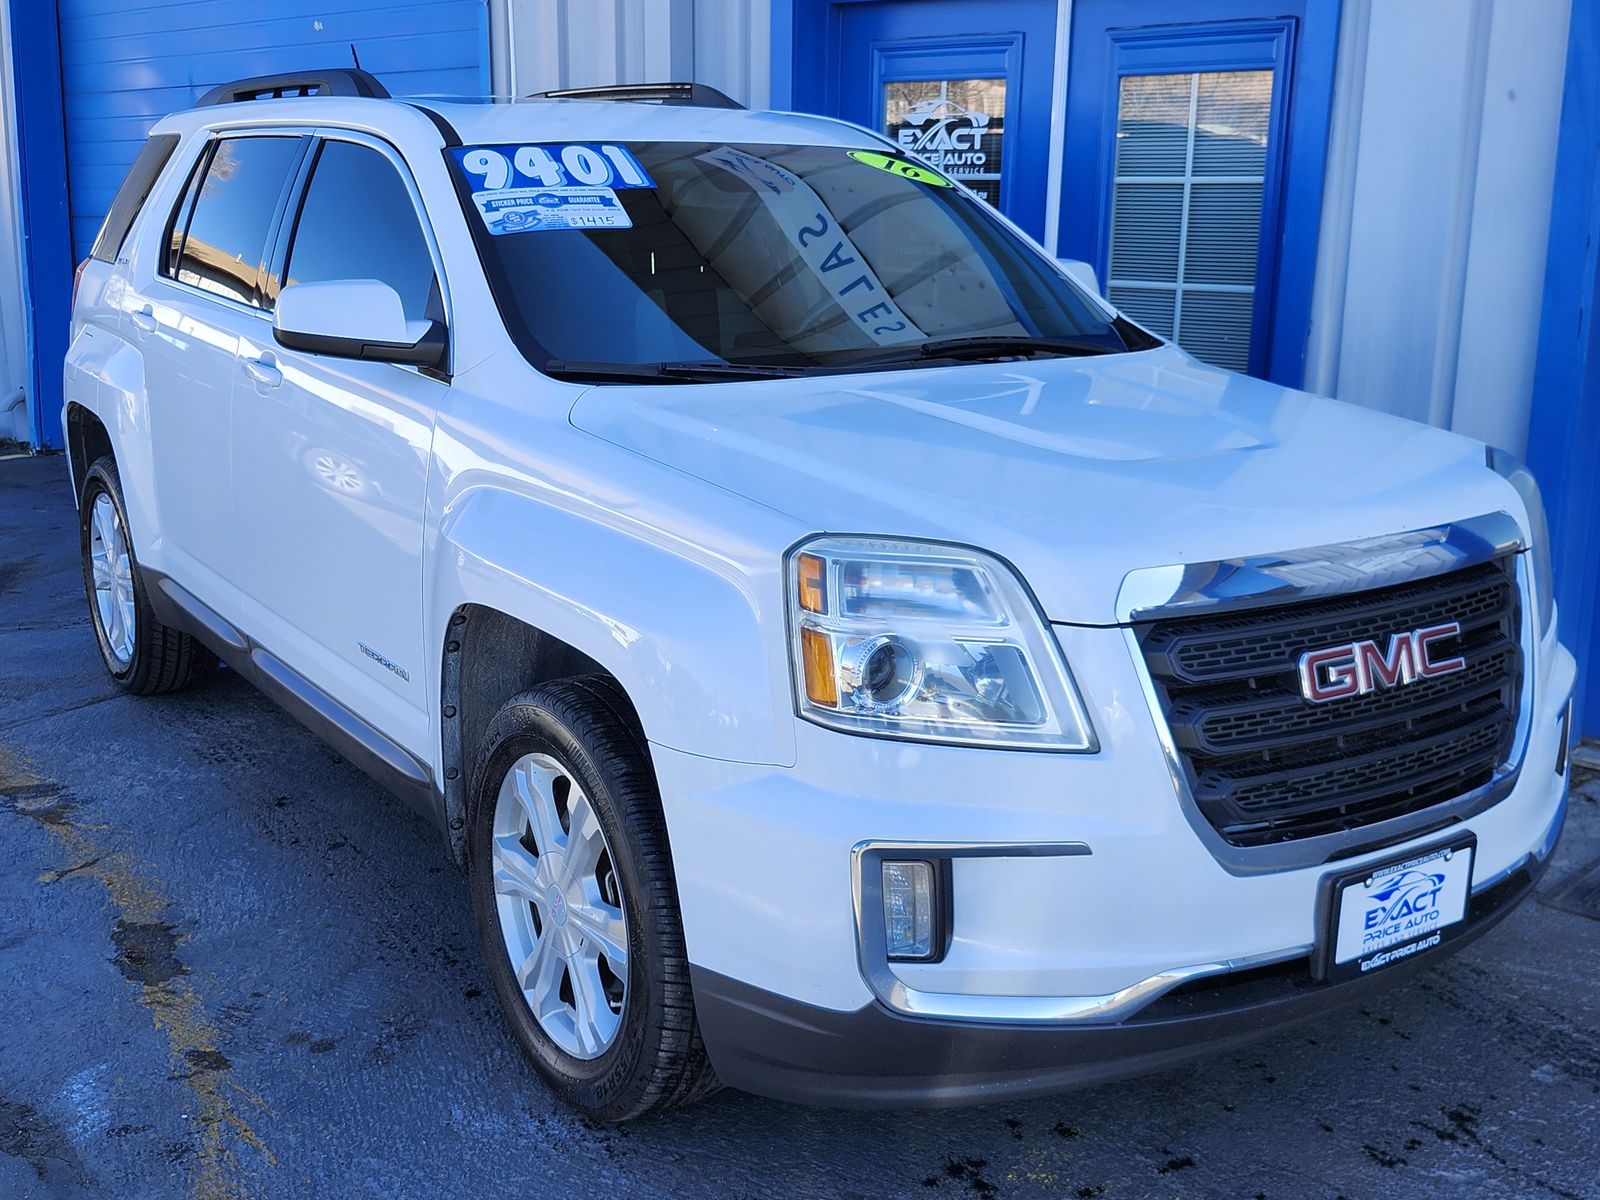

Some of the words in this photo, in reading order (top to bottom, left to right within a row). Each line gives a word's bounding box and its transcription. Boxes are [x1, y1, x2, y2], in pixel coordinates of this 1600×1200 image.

[898, 127, 988, 150] EXACT
[463, 145, 650, 190] 9401
[883, 160, 921, 178] 16
[943, 152, 986, 165] AUTO
[948, 167, 985, 175] SERVICE
[490, 198, 515, 208] STICKER
[515, 197, 534, 206] PRICE
[568, 196, 601, 204] GUARANTEE
[570, 215, 615, 226] $1415
[1298, 621, 1466, 703] GMC
[1364, 886, 1443, 930] EXACT
[1363, 922, 1401, 945] PRICE
[1405, 910, 1440, 930] AUTO
[1361, 953, 1391, 972] EXACT
[1391, 943, 1417, 960] PRICE
[1417, 934, 1440, 951] AUTO
